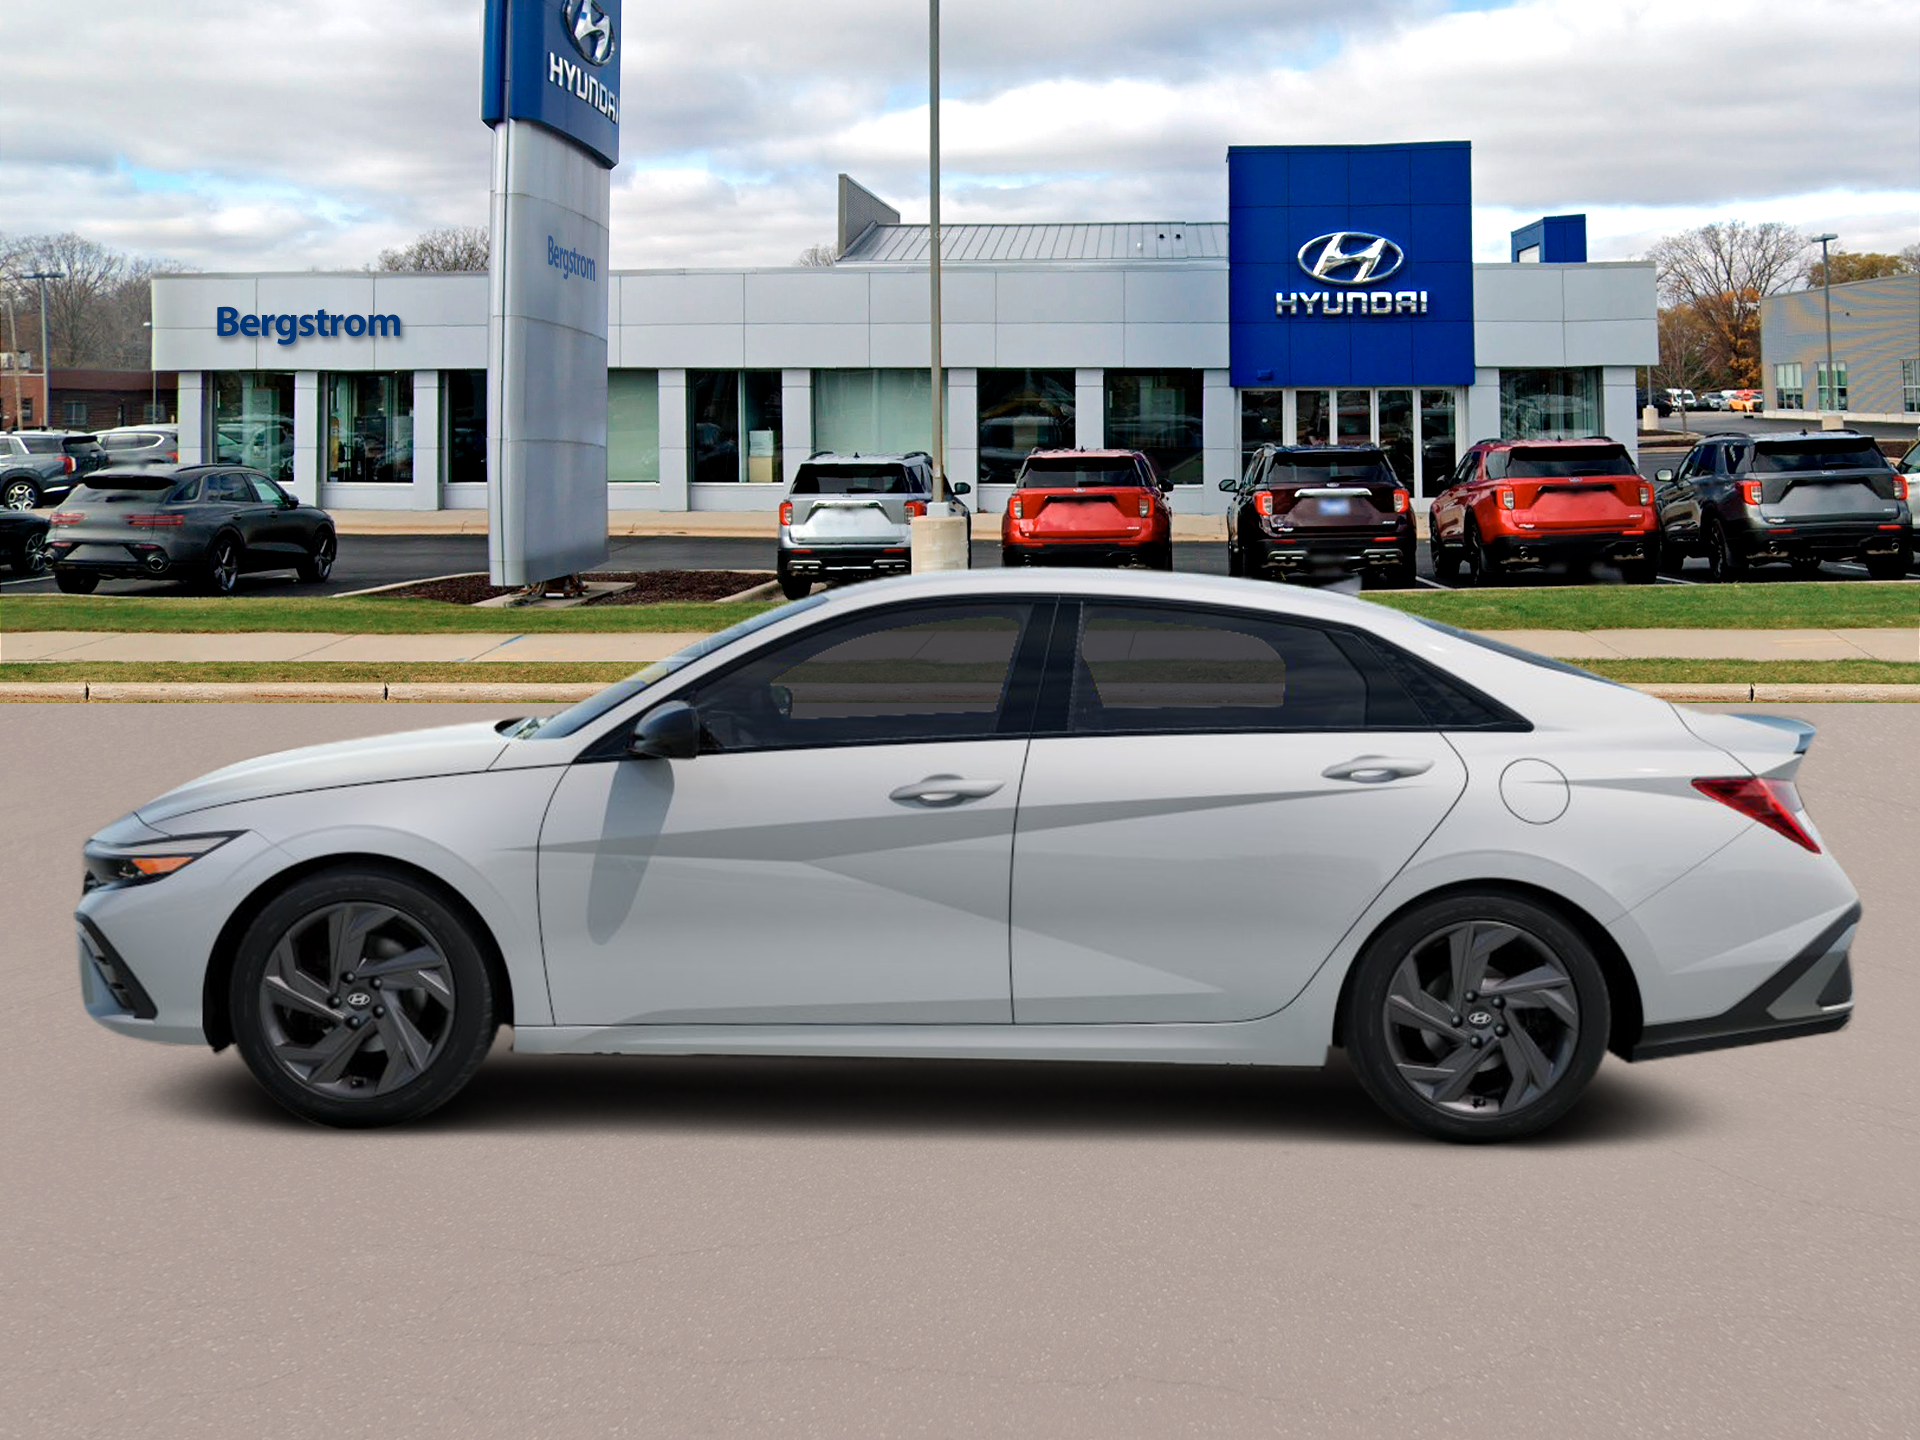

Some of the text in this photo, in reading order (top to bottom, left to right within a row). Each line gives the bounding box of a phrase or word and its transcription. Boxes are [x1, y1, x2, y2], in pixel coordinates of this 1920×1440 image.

[549, 52, 619, 124] HYUNDAI
[548, 235, 595, 282] Bergstrom
[1275, 290, 1428, 315] HYUNDAI
[217, 306, 401, 346] Bergstrom
